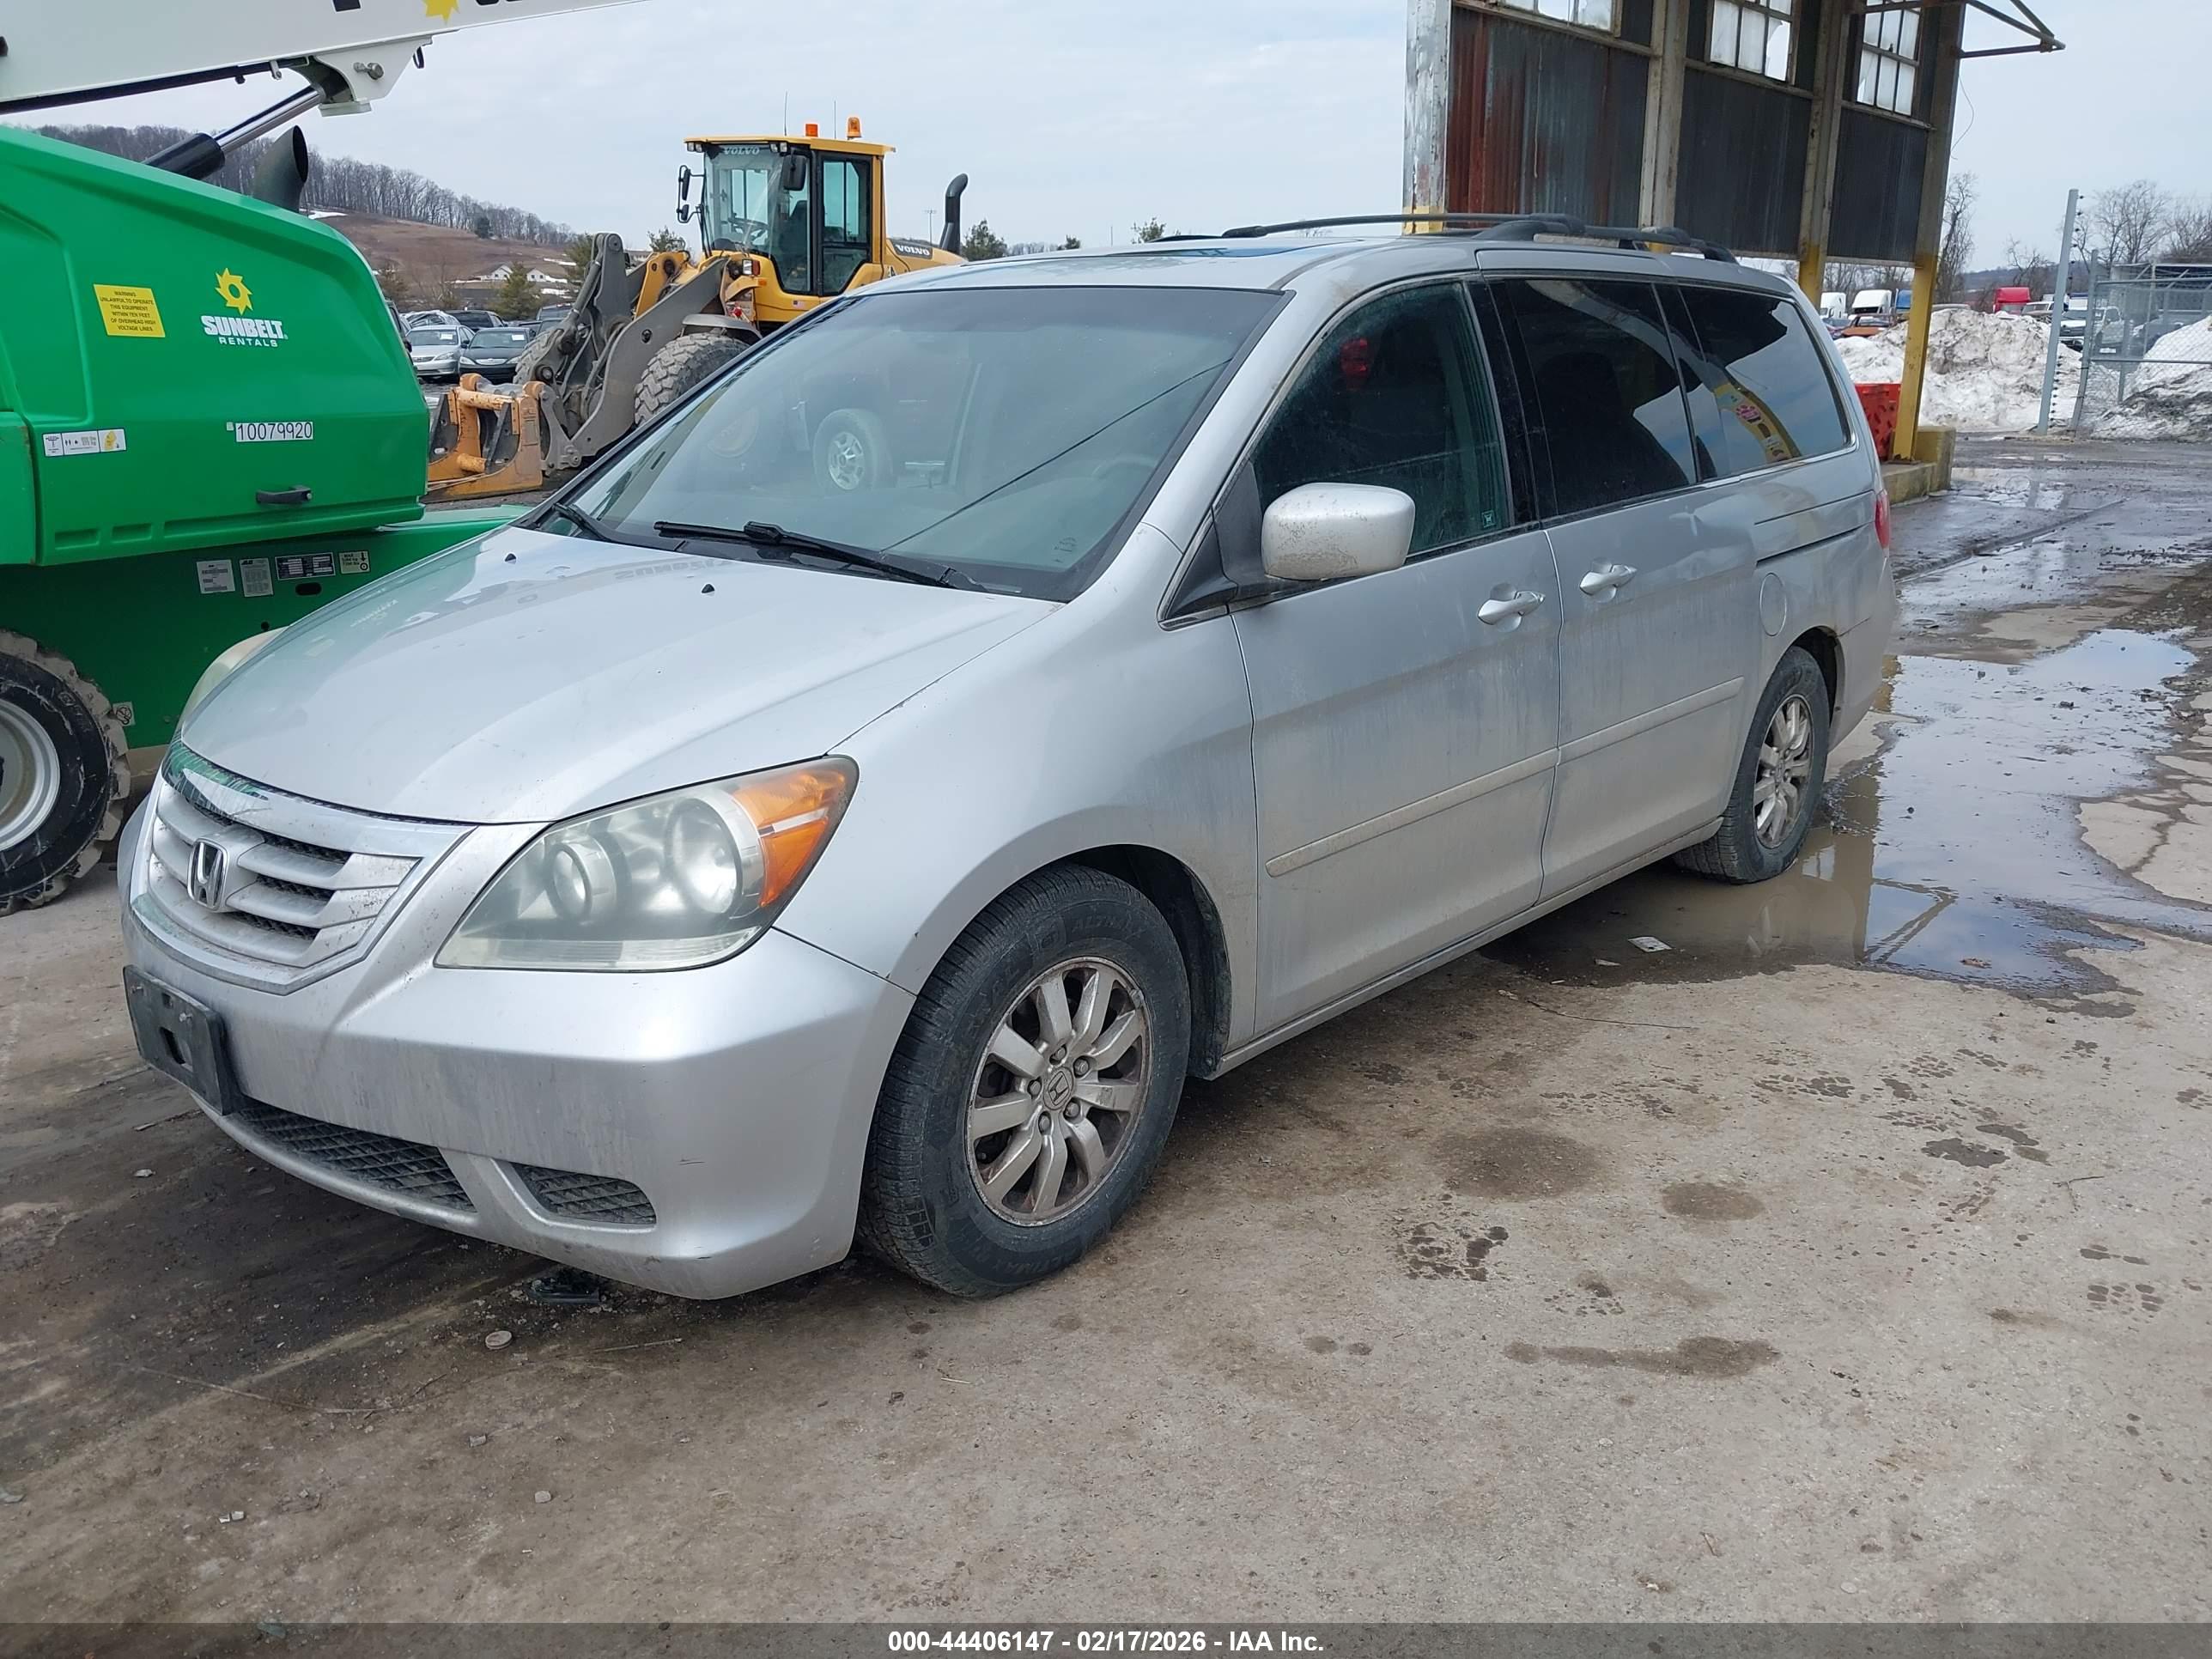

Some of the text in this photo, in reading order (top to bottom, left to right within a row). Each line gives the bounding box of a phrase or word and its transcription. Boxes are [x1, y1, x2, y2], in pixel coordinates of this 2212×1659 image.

[896, 245, 930, 256] VOLVO
[201, 315, 284, 339] SUNBELT
[219, 337, 278, 347] RENTALS
[238, 422, 313, 441] 10079920
